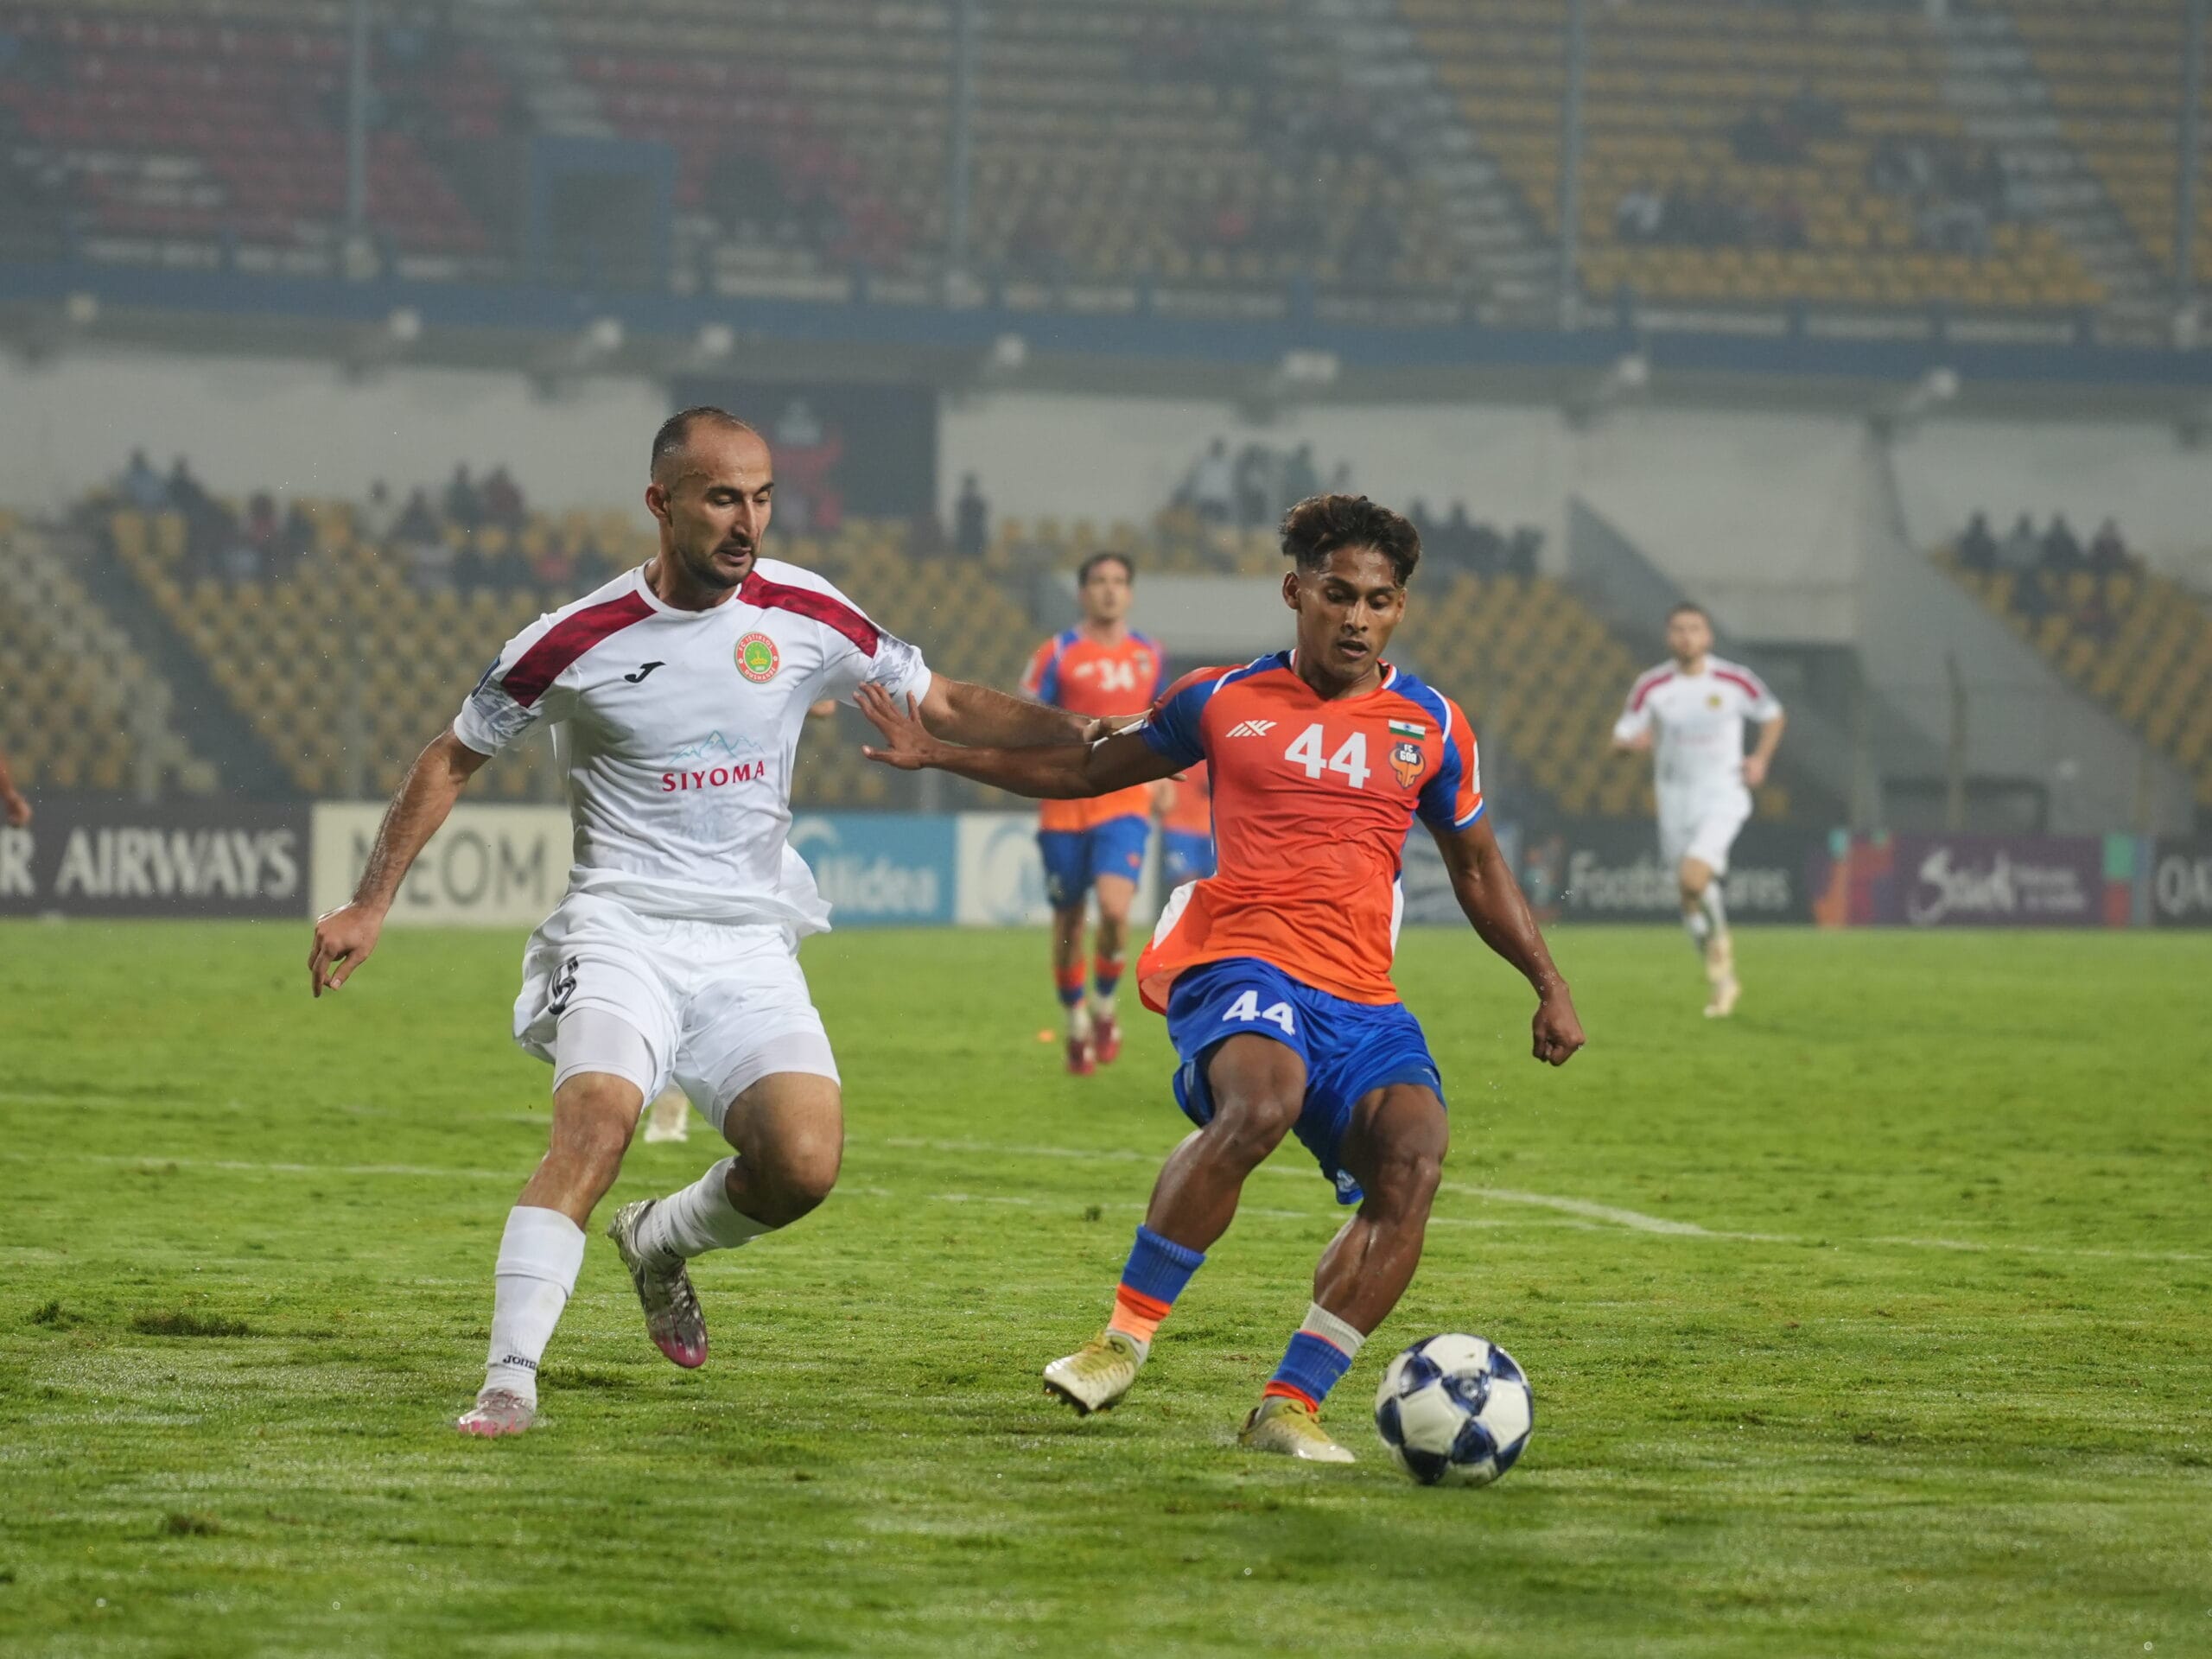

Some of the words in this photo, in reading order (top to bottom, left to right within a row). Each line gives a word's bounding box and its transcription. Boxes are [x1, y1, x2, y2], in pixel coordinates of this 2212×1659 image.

[1285, 723, 1371, 789] 44
[1400, 750, 1417, 764] GOA
[1404, 744, 1414, 753] FC
[662, 760, 766, 792] SIYOMA
[55, 827, 297, 899] AIRWAYS
[1222, 989, 1295, 1036] 44
